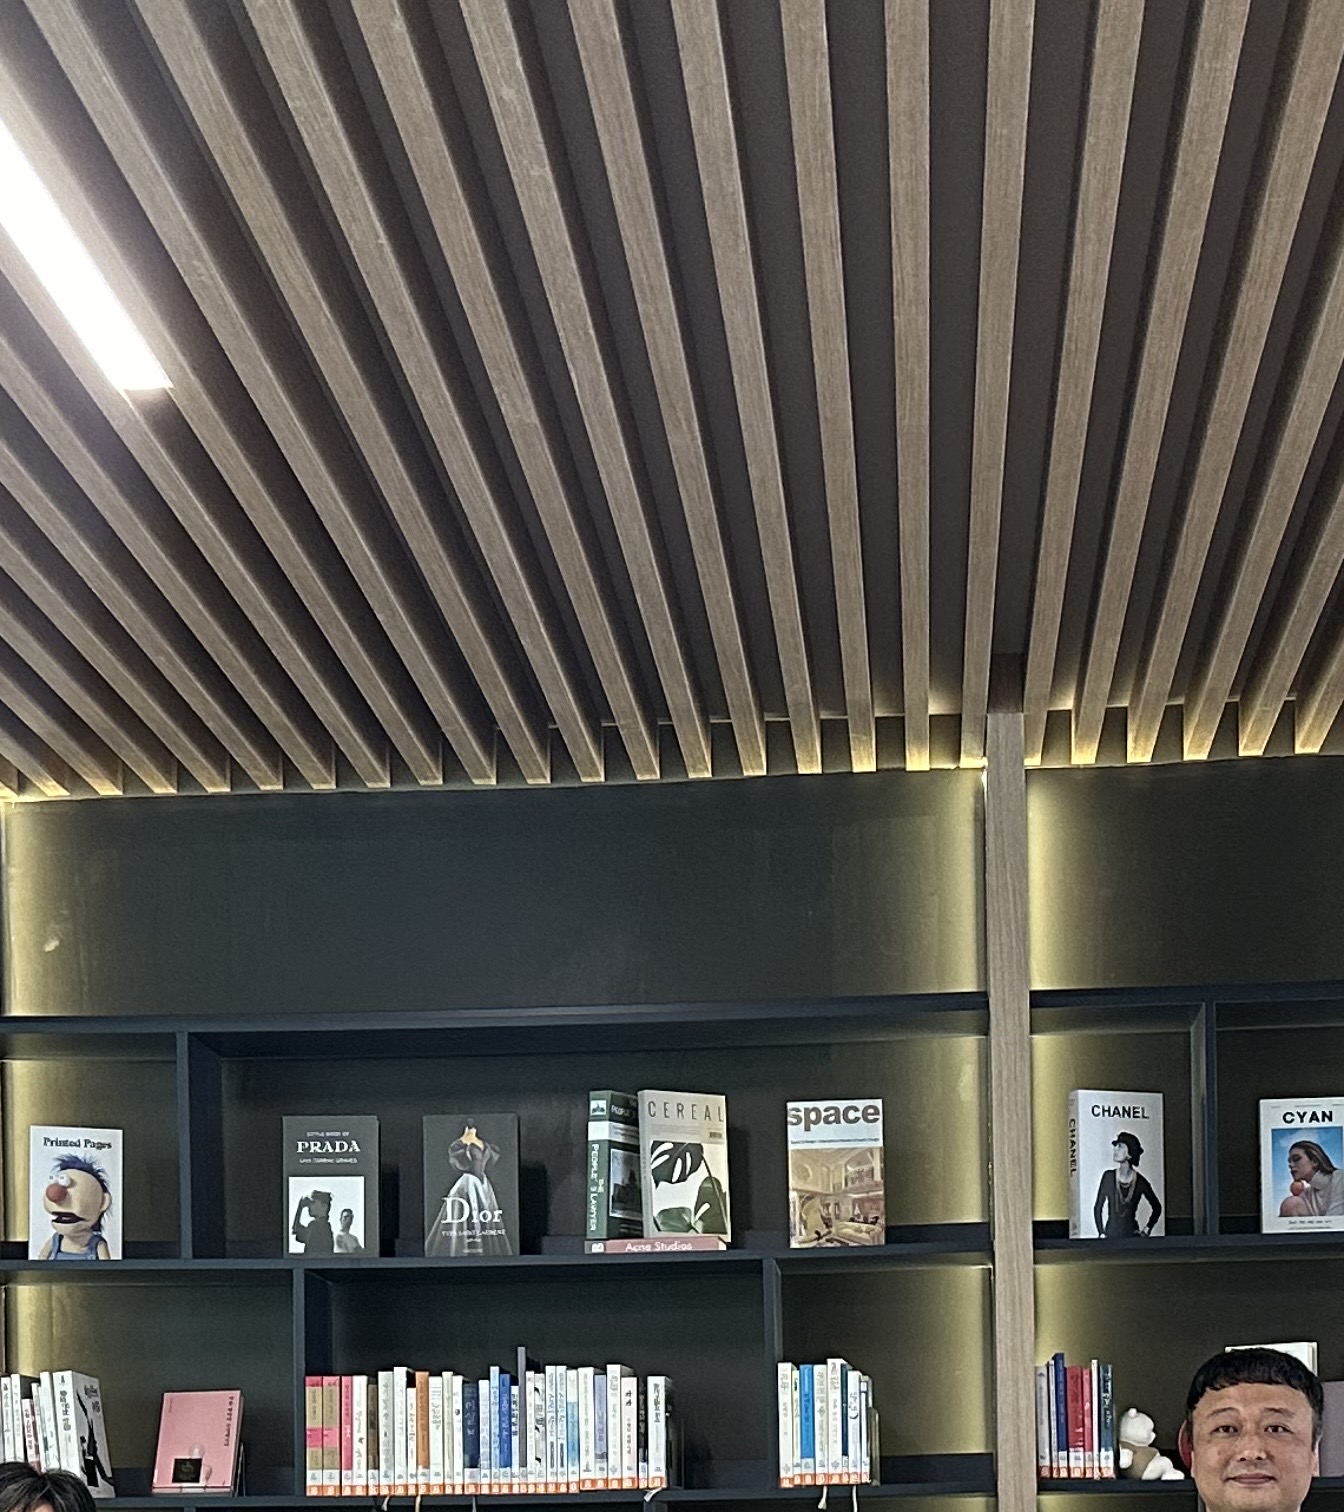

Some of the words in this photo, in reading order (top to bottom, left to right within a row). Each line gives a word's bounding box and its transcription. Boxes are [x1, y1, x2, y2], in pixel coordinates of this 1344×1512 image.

[647, 1101, 724, 1122] CEREAL
[788, 1104, 881, 1132] space
[1091, 1104, 1150, 1119] CHANEL
[1282, 1110, 1333, 1124] CYAN
[43, 1136, 81, 1148] Printed
[84, 1138, 112, 1150] Pages
[296, 1140, 361, 1153] PRADA
[1068, 1118, 1077, 1177] CHANEL
[441, 1197, 503, 1223] Dior
[626, 1242, 652, 1252] Acne
[655, 1241, 693, 1252] Studios
